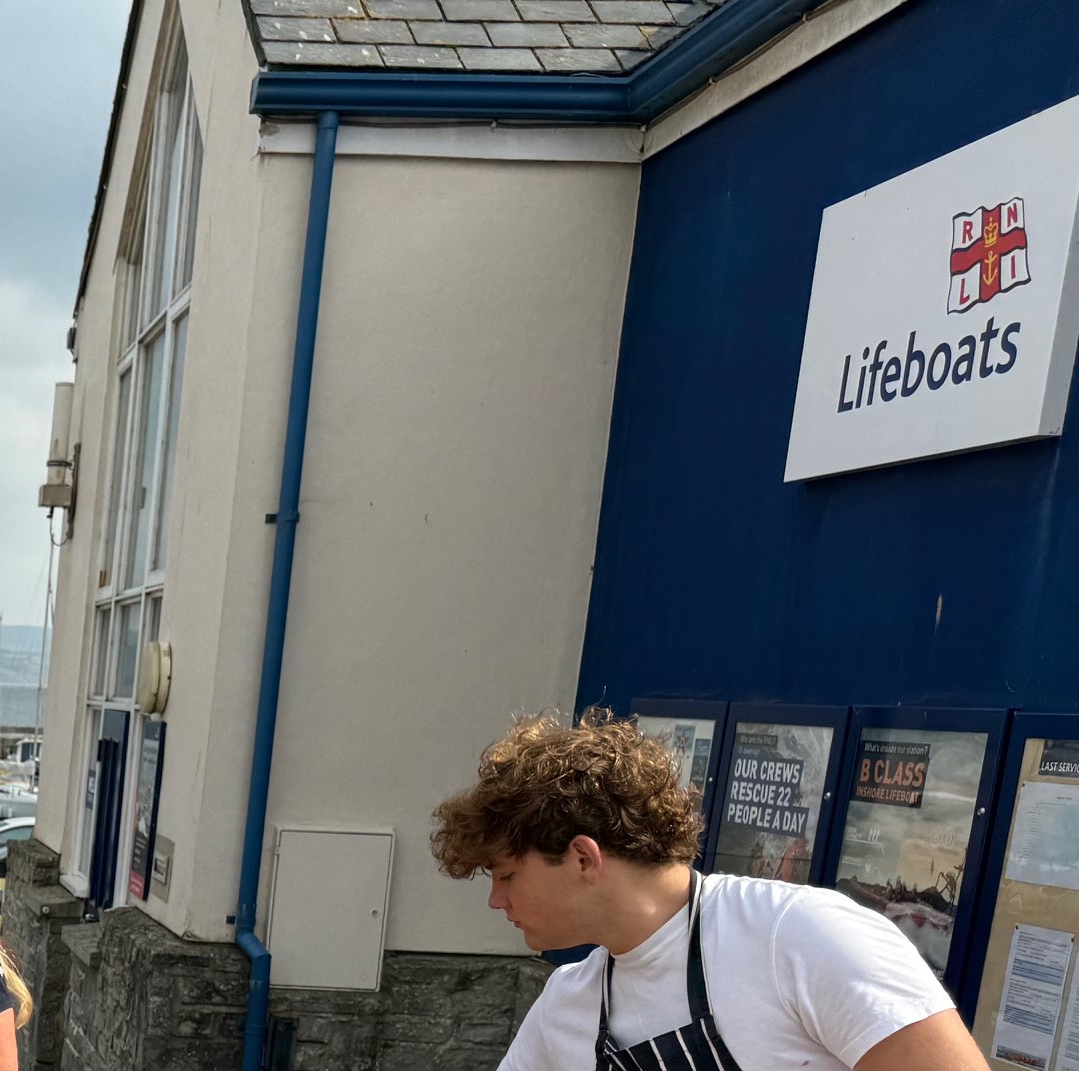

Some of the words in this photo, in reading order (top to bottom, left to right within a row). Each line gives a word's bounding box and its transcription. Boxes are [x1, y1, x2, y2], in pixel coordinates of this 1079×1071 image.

[961, 219, 973, 244] R
[1007, 202, 1019, 227] N
[959, 277, 971, 306] L
[1010, 255, 1017, 280] I
[837, 316, 1022, 413] Lifeboats
[734, 758, 758, 779] OUR
[760, 761, 801, 784] CREWS
[860, 758, 871, 782] B
[874, 759, 926, 787] CLASS
[1041, 761, 1058, 772] LAST
[730, 781, 776, 805] RESCUE
[776, 786, 792, 807] 22
[856, 785, 885, 799] INSHORE
[886, 789, 920, 804] LIFEBOAT
[727, 803, 773, 828] PEOPLE
[772, 809, 780, 830] A
[782, 811, 806, 833] DAY
